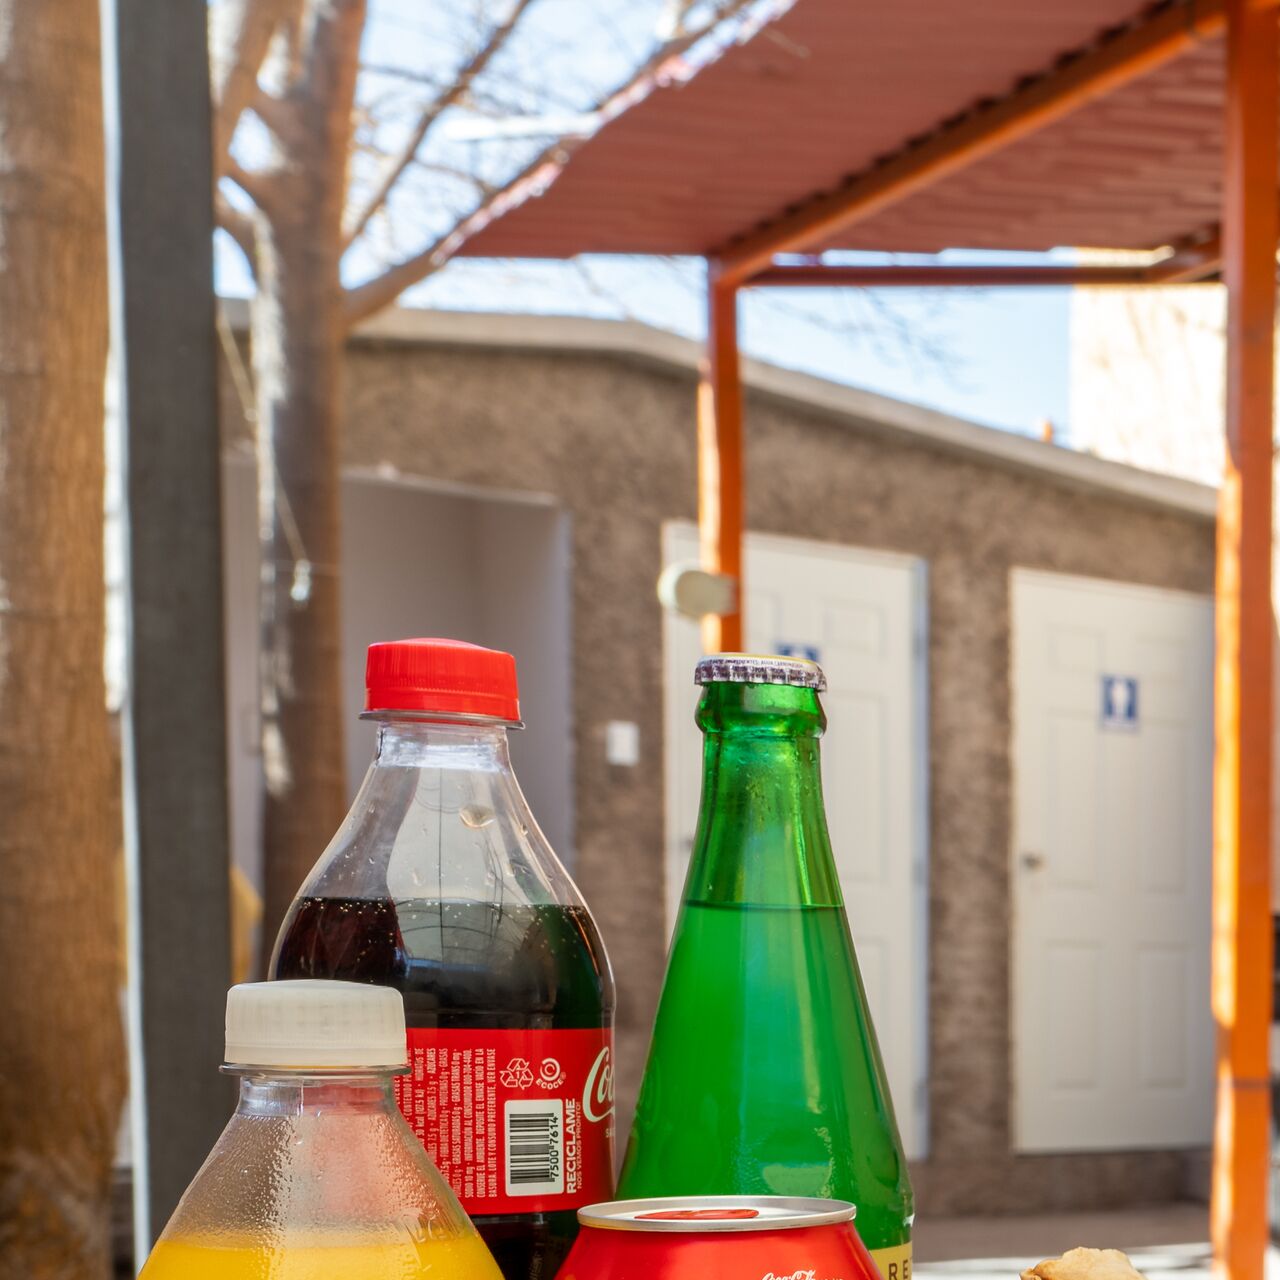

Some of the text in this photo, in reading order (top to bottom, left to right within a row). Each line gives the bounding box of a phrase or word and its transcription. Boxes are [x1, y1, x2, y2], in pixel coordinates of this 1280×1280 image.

[536, 1077, 564, 1090] ECOCE
[550, 1116, 559, 1179] 7500 7614
[566, 1098, 577, 1194] RECICLAME
